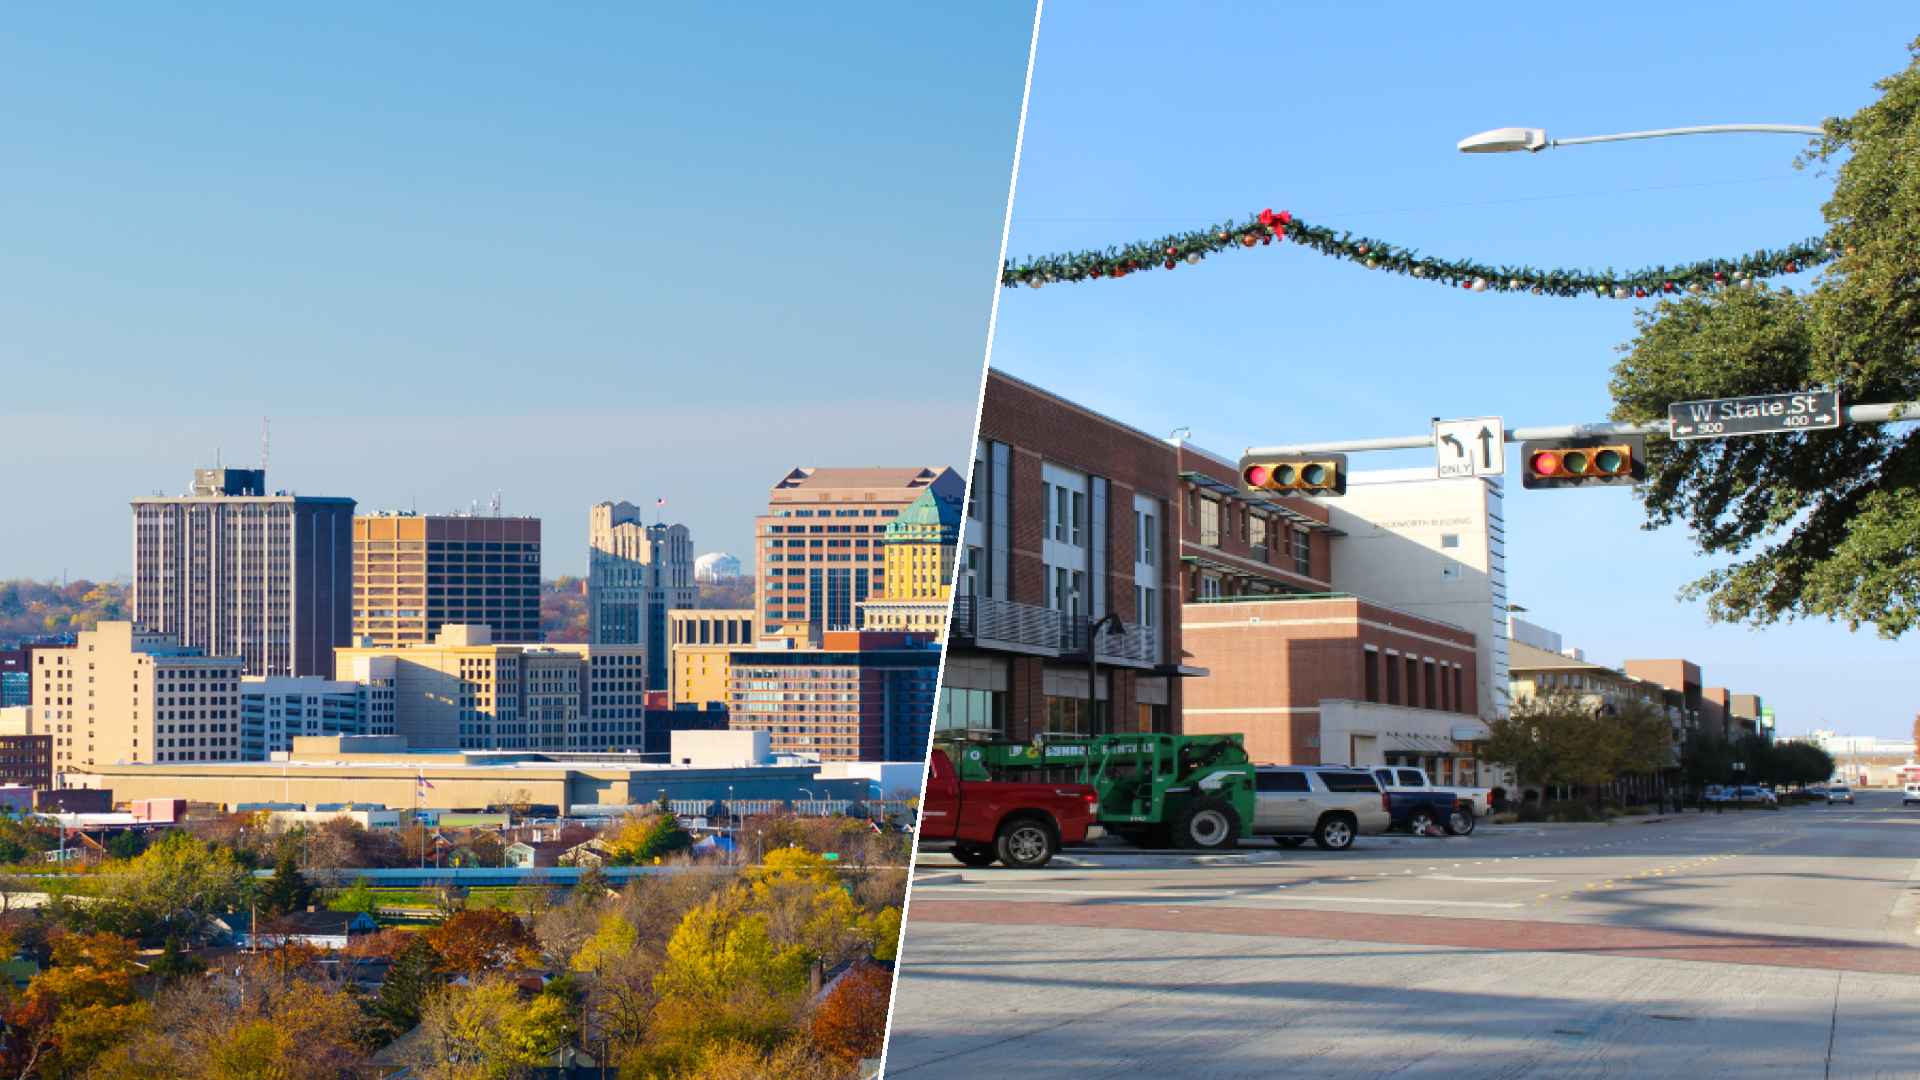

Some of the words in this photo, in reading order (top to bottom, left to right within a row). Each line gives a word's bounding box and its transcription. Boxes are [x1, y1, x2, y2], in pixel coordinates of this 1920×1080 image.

[1690, 404, 1712, 422] W
[1721, 400, 1784, 420] State
[1791, 395, 1817, 413] St
[1784, 415, 1809, 426] 400
[1440, 463, 1471, 475] ONLY
